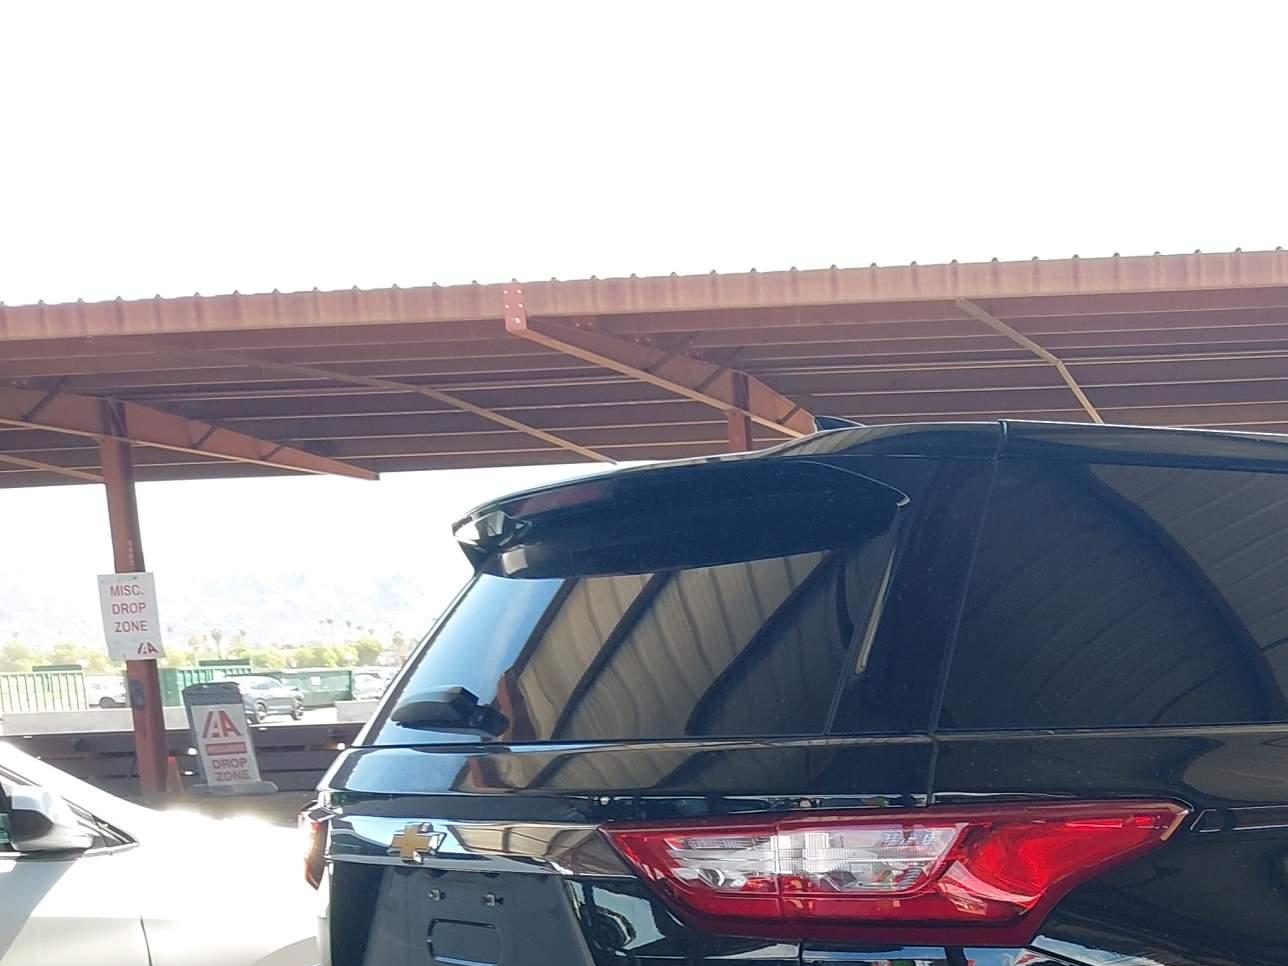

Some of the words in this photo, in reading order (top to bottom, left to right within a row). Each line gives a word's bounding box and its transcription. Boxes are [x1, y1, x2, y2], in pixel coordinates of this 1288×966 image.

[110, 584, 145, 597] MISC.
[111, 602, 146, 615] DROP
[114, 620, 148, 633] ZONE
[212, 757, 248, 769] DROP
[214, 769, 251, 782] ZONE
